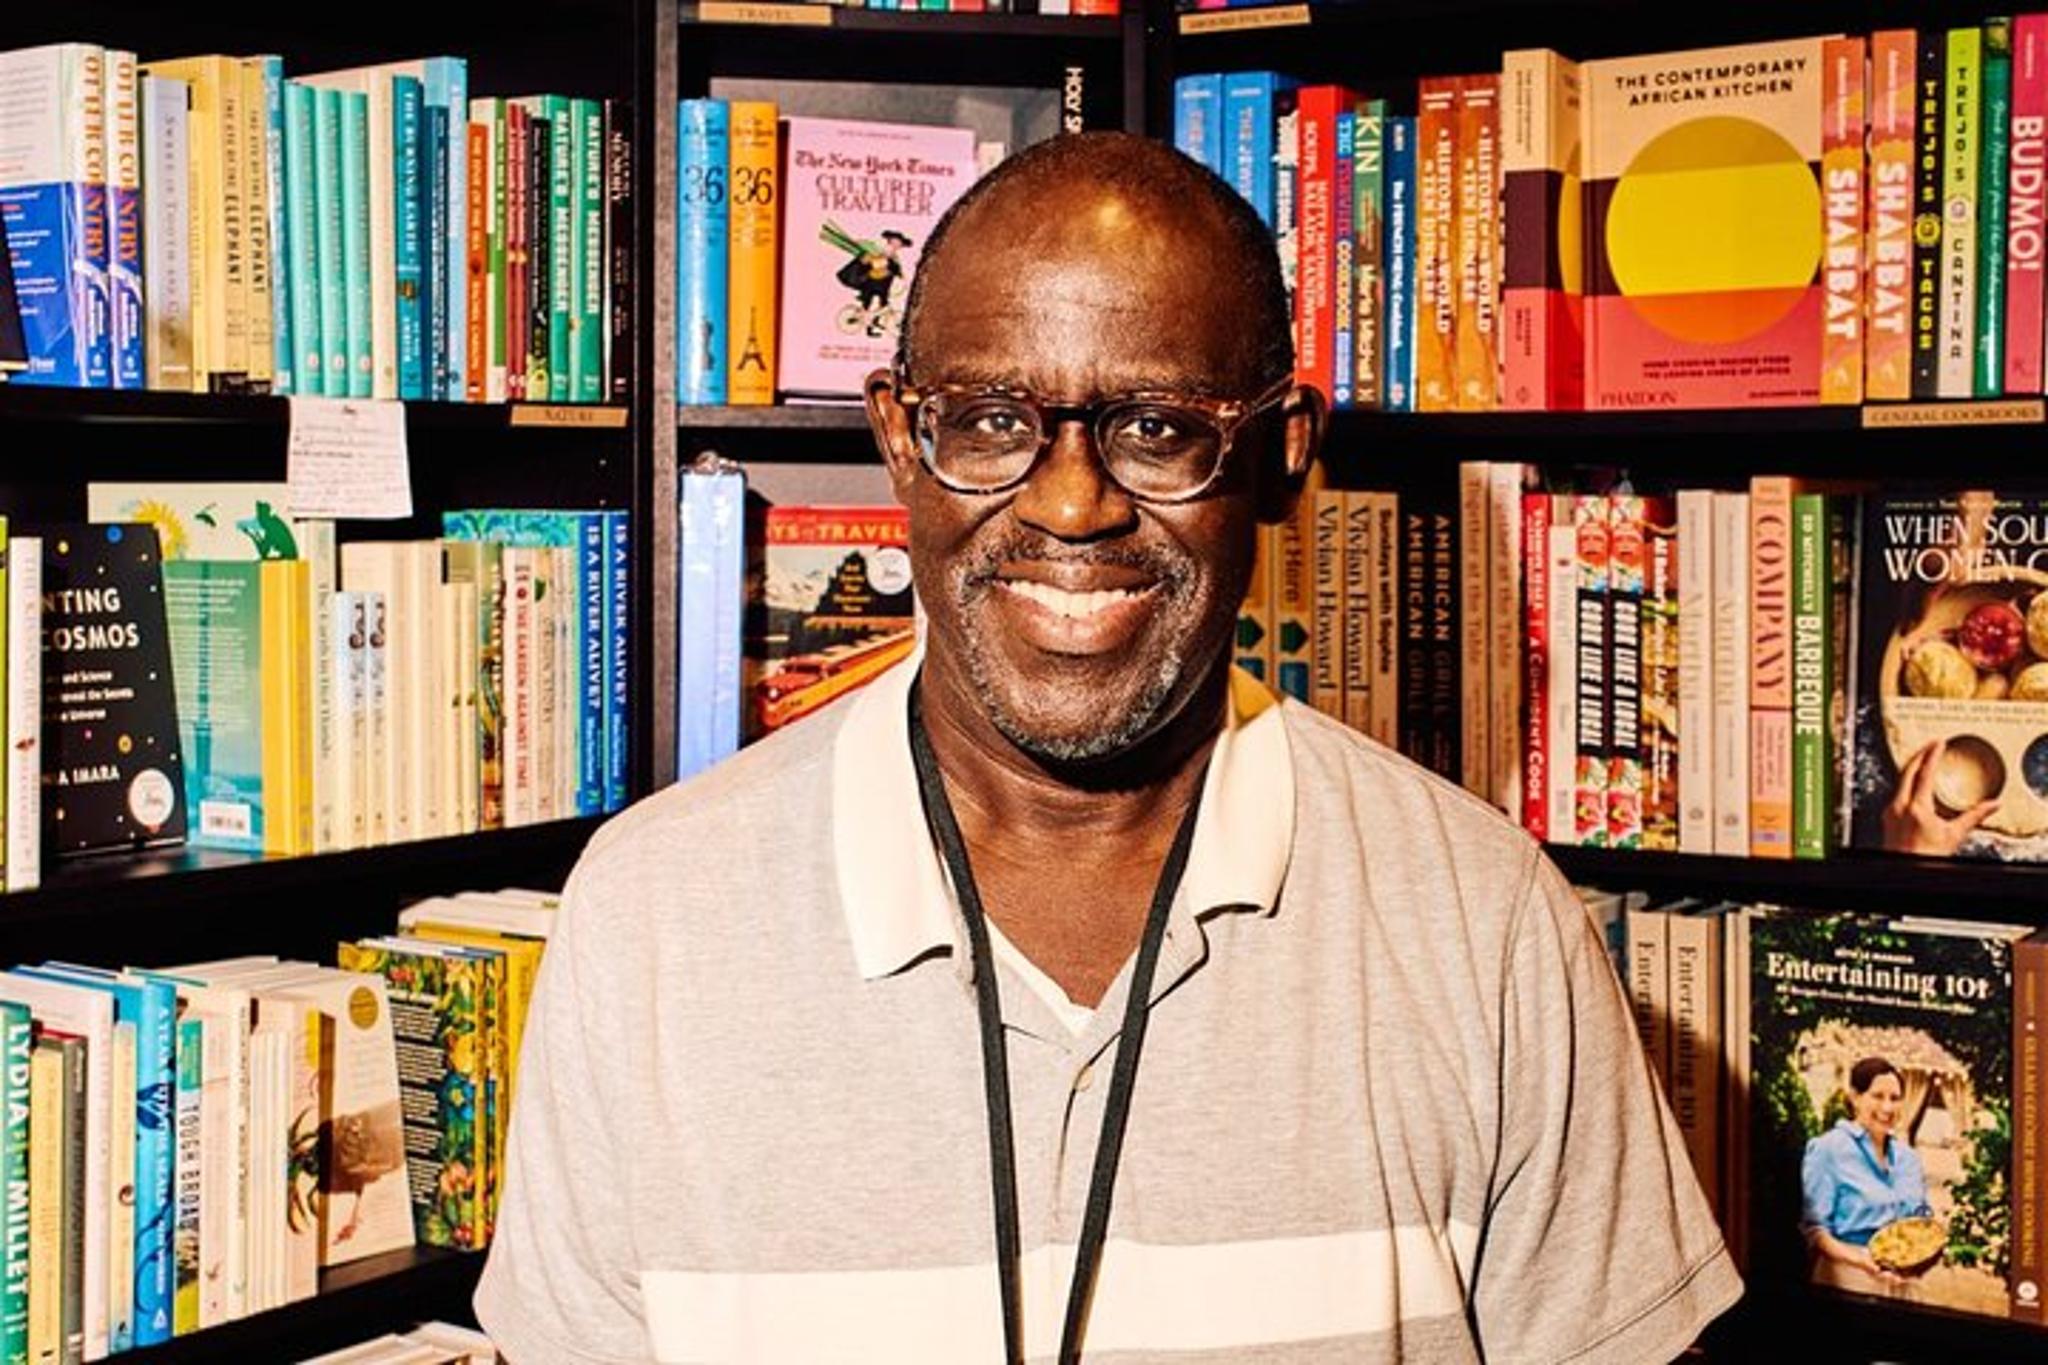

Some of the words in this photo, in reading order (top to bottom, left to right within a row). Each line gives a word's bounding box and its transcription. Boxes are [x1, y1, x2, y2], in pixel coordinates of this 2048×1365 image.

[1615, 75, 1648, 90] THE
[1654, 58, 1808, 86] CONTEMPORARY
[1628, 87, 1707, 107] AFRICAN
[1713, 78, 1794, 99] KITCHEN
[1354, 116, 1381, 173] KIN
[1954, 67, 1967, 181] TREJO'S
[683, 165, 725, 206] 36
[733, 165, 774, 206] 36
[795, 149, 825, 169] The
[827, 152, 862, 170] New
[865, 155, 902, 177] York
[907, 157, 957, 177] Times
[815, 172, 937, 199] CULTURED
[2009, 115, 2045, 271] BUDMO!
[226, 195, 241, 284] ELEPHANT
[820, 192, 934, 216] TRAVELER
[250, 204, 265, 294] ELEPHANT
[1827, 168, 1857, 340] SHABBAT
[1875, 161, 1907, 334] SHABBAT
[1920, 259, 1934, 349] TACOS
[1951, 238, 1964, 359] CANTINA
[588, 525, 602, 545] IS
[588, 550, 602, 566] A
[614, 524, 627, 544] IS
[614, 548, 627, 562] A
[816, 521, 908, 540] TRAVEL
[1318, 505, 1339, 584] Vivian
[1348, 506, 1370, 587] Vivian
[1884, 514, 1972, 545] WHEN
[1884, 548, 2018, 582] WOMEN
[588, 570, 602, 631] RIVER
[614, 572, 627, 629] RIVER
[1408, 514, 1424, 640] AMERICAN
[1434, 514, 1450, 641] AMERICAN
[1757, 514, 1785, 691] COMPANY
[588, 637, 602, 709] ALIVE?
[614, 634, 627, 705] ALIVE?
[1318, 591, 1339, 690] Howard
[1348, 593, 1370, 693] Howard
[1797, 614, 1822, 736] BARBEQUE
[1766, 952, 1938, 998] Entertaining
[8, 1023, 28, 1128] LYDIA
[8, 1180, 28, 1297] MILLET
